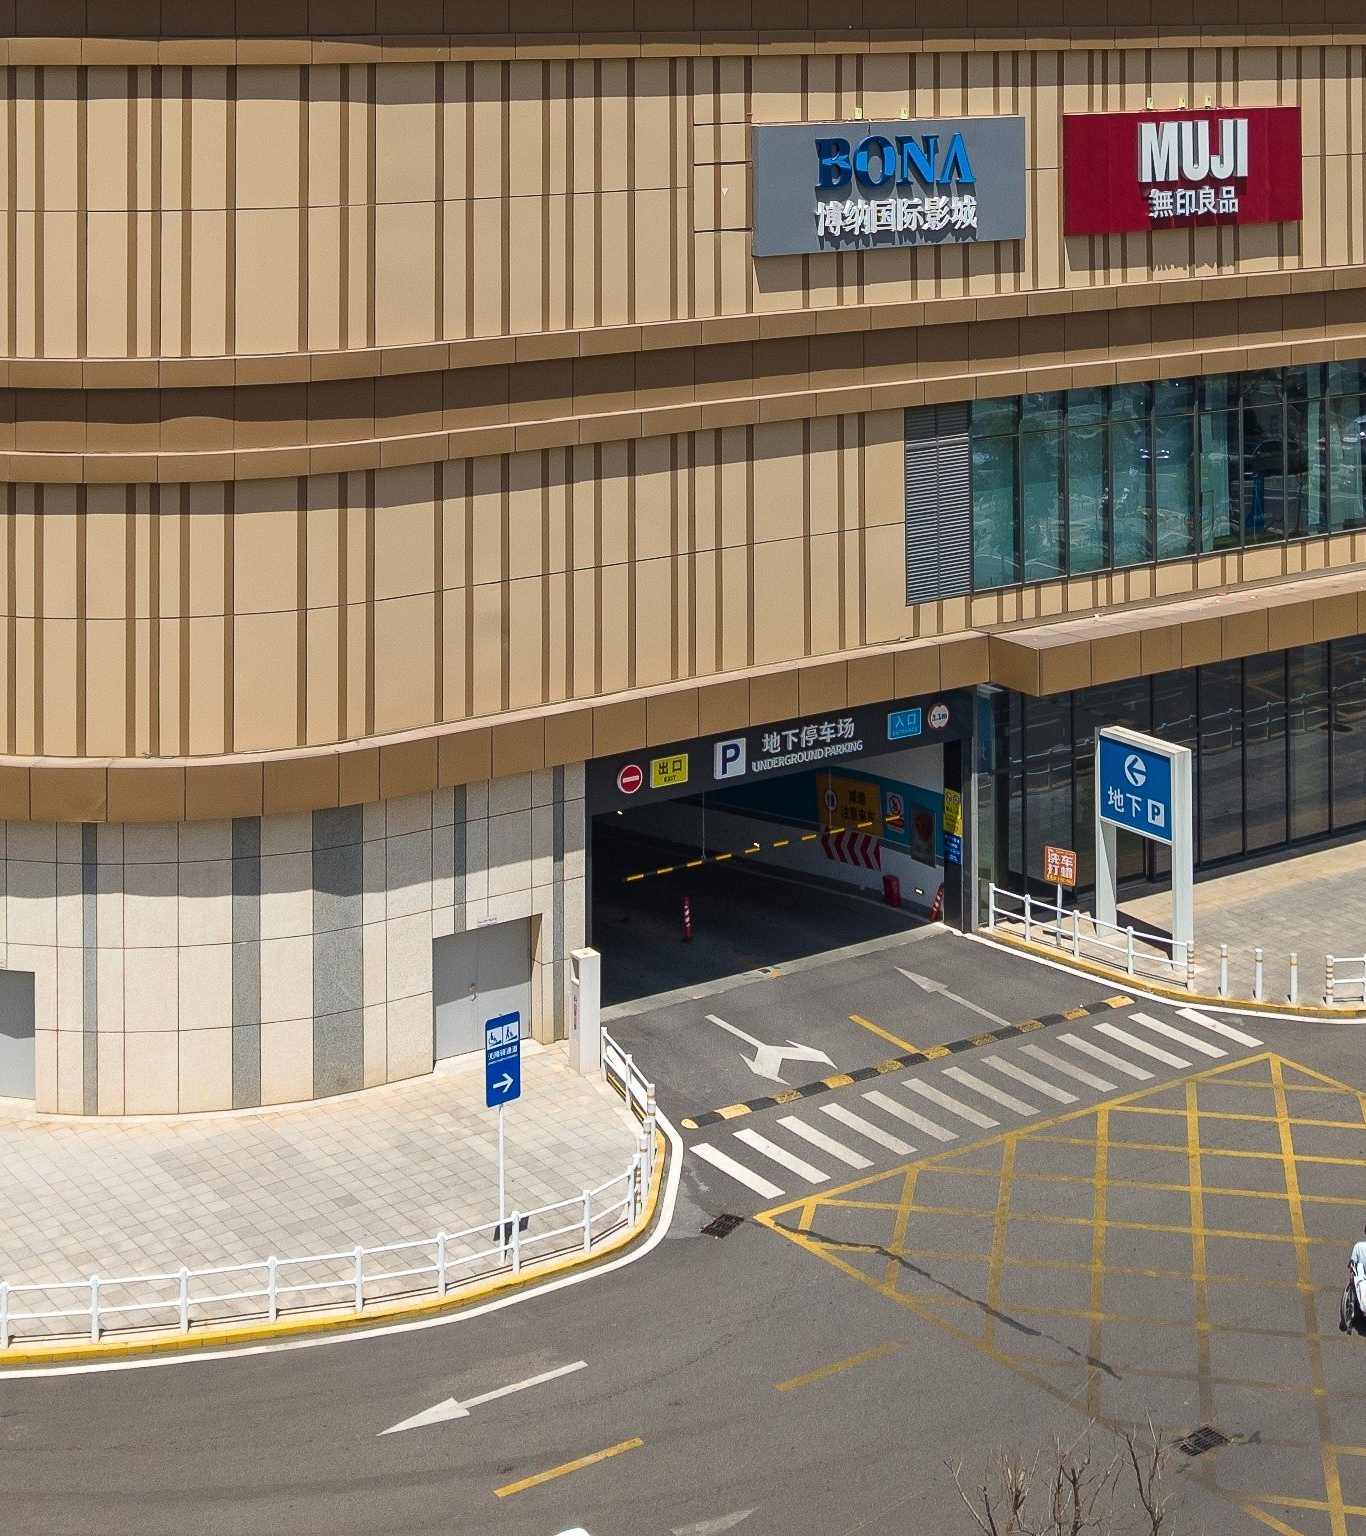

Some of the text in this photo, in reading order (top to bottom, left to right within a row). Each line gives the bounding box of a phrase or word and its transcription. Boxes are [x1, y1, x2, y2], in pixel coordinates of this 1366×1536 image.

[814, 132, 977, 190] BONA
[1137, 117, 1249, 183] MUJI
[813, 194, 978, 237] 博纳国际影城
[1148, 185, 1239, 219] 無印良品
[761, 717, 855, 754] 地下停车场
[895, 713, 916, 728] 入口
[658, 758, 682, 776] 出口
[721, 743, 741, 776] P
[751, 740, 864, 773] UNDERGROUND PARKING
[663, 774, 677, 783] EXIT
[1107, 785, 1162, 822] 地下 P
